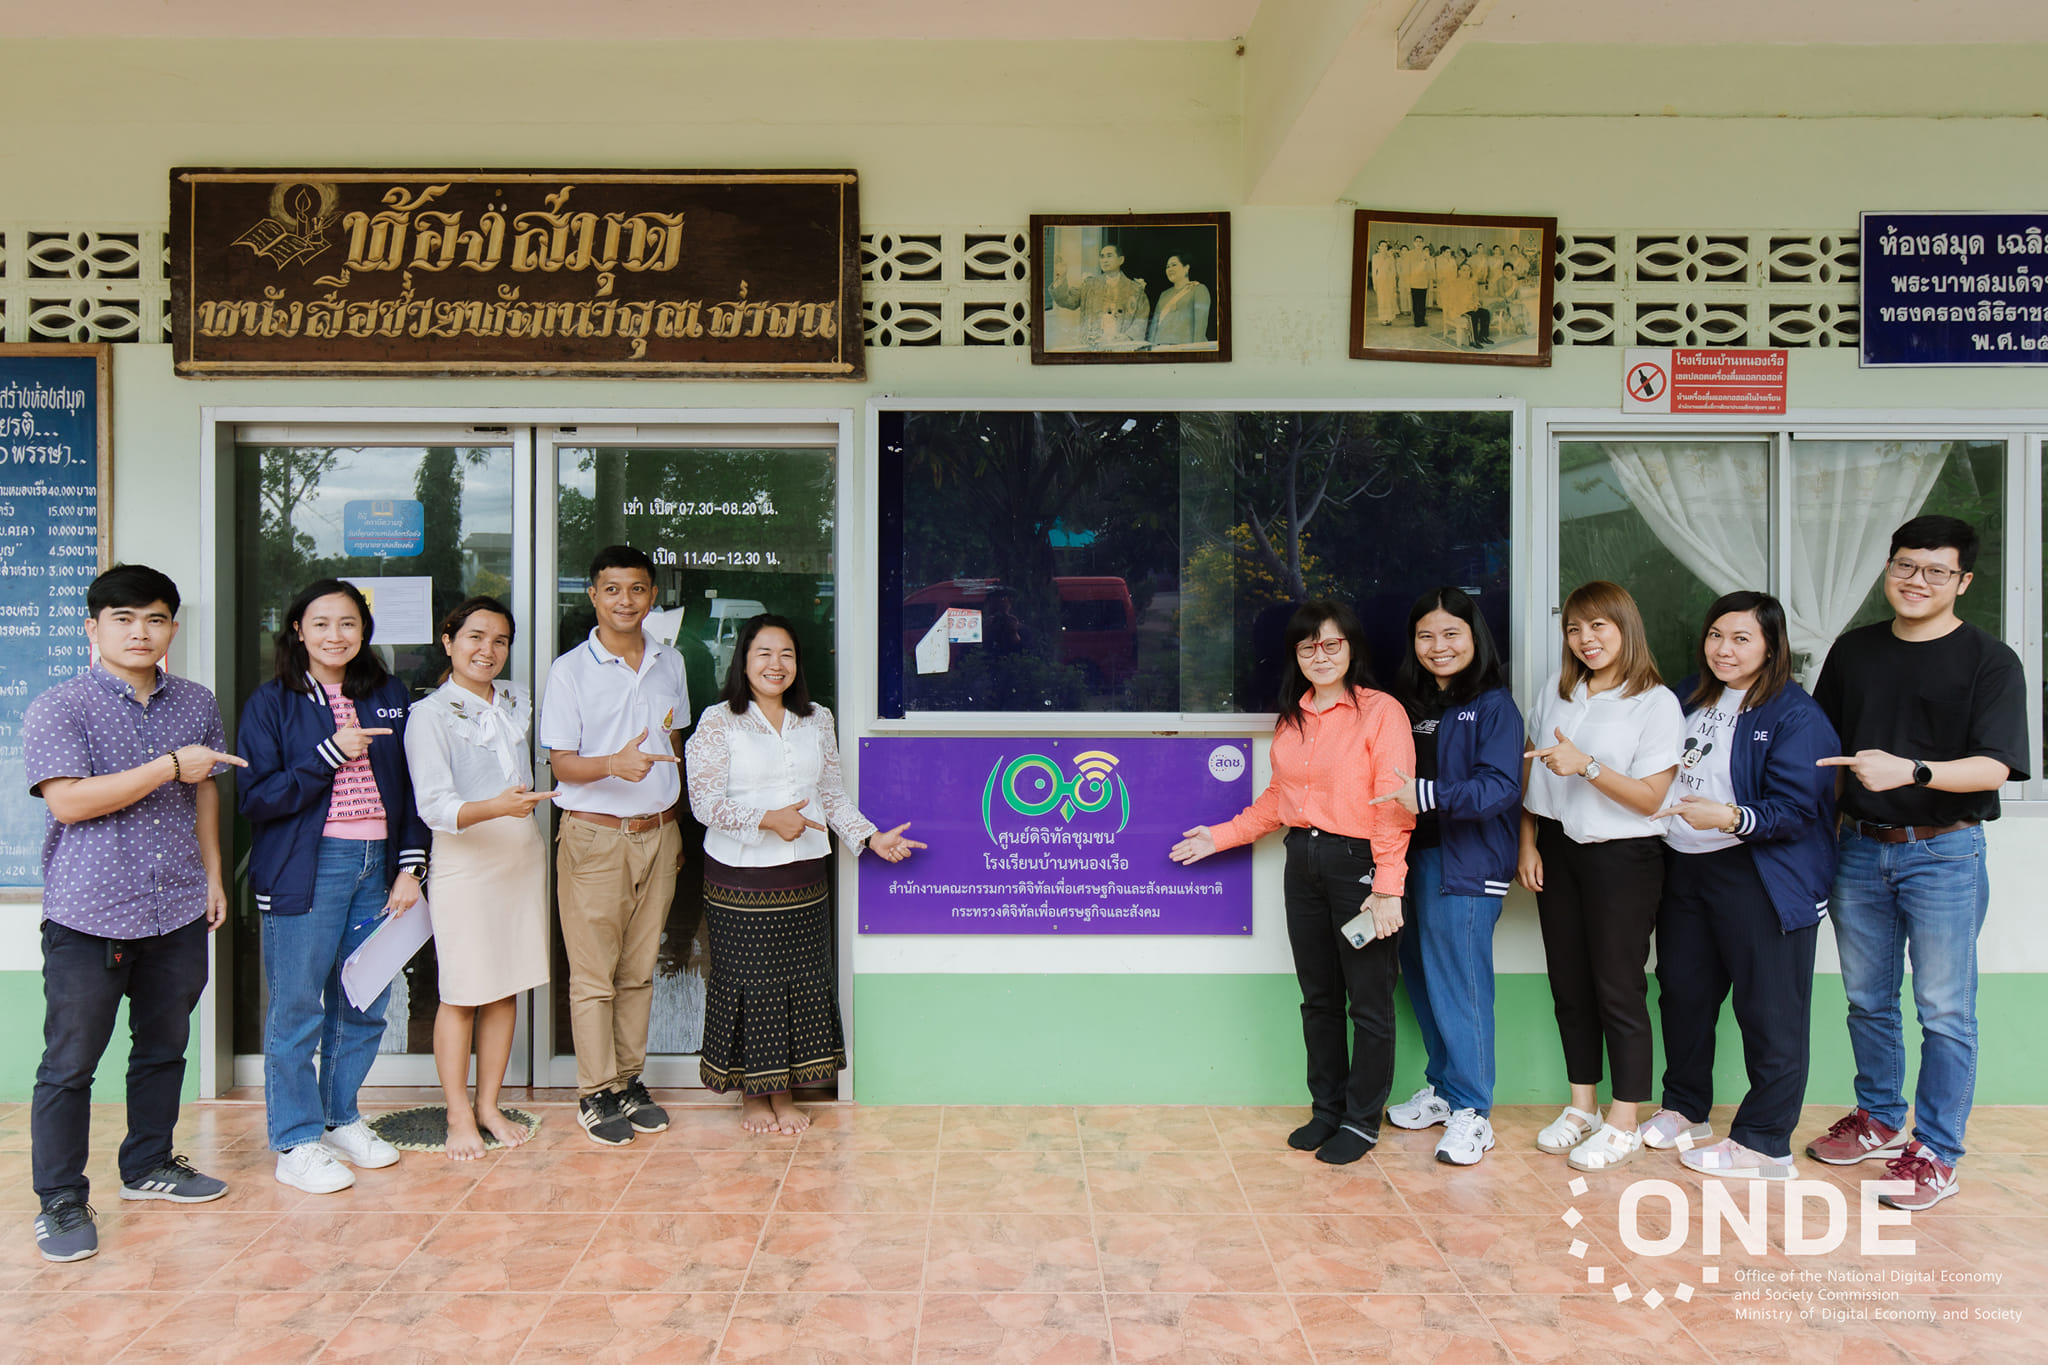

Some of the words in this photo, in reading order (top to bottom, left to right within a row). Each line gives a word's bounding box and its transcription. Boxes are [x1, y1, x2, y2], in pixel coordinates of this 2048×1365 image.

[342, 184, 686, 297] ห้องสมุด
[1879, 225, 1985, 265] ห้องสมุด
[1997, 226, 2048, 256] เฉลิ
[1675, 352, 1785, 366] โรงเรียนบ้านหนองเรือ
[76, 486, 97, 497] บาท
[76, 506, 97, 517] บาท
[649, 497, 674, 516] เปิด
[679, 502, 757, 516] 07.30-08.20
[764, 502, 779, 516] น.
[77, 525, 97, 536] บาท
[77, 545, 98, 557] บาท
[652, 546, 677, 565] เปิด
[683, 551, 761, 565] 11.40-12.30
[765, 551, 781, 565] น.
[77, 565, 97, 577] บาท
[1215, 758, 1240, 768] สดช
[998, 826, 1116, 850] ศูนย์ดิจิทัลชุมชน
[983, 853, 1129, 871] โรงเรียนบ้านหนองเรือ
[888, 879, 1223, 899] สำนักงานคณะกรรมการดิจิทัลเพื่อเศรษฐกิจและสังคมแห่งชาติ
[951, 900, 1161, 922] กระทรวงดิจิทัลเพื่อเศรษฐกิจและสังคม
